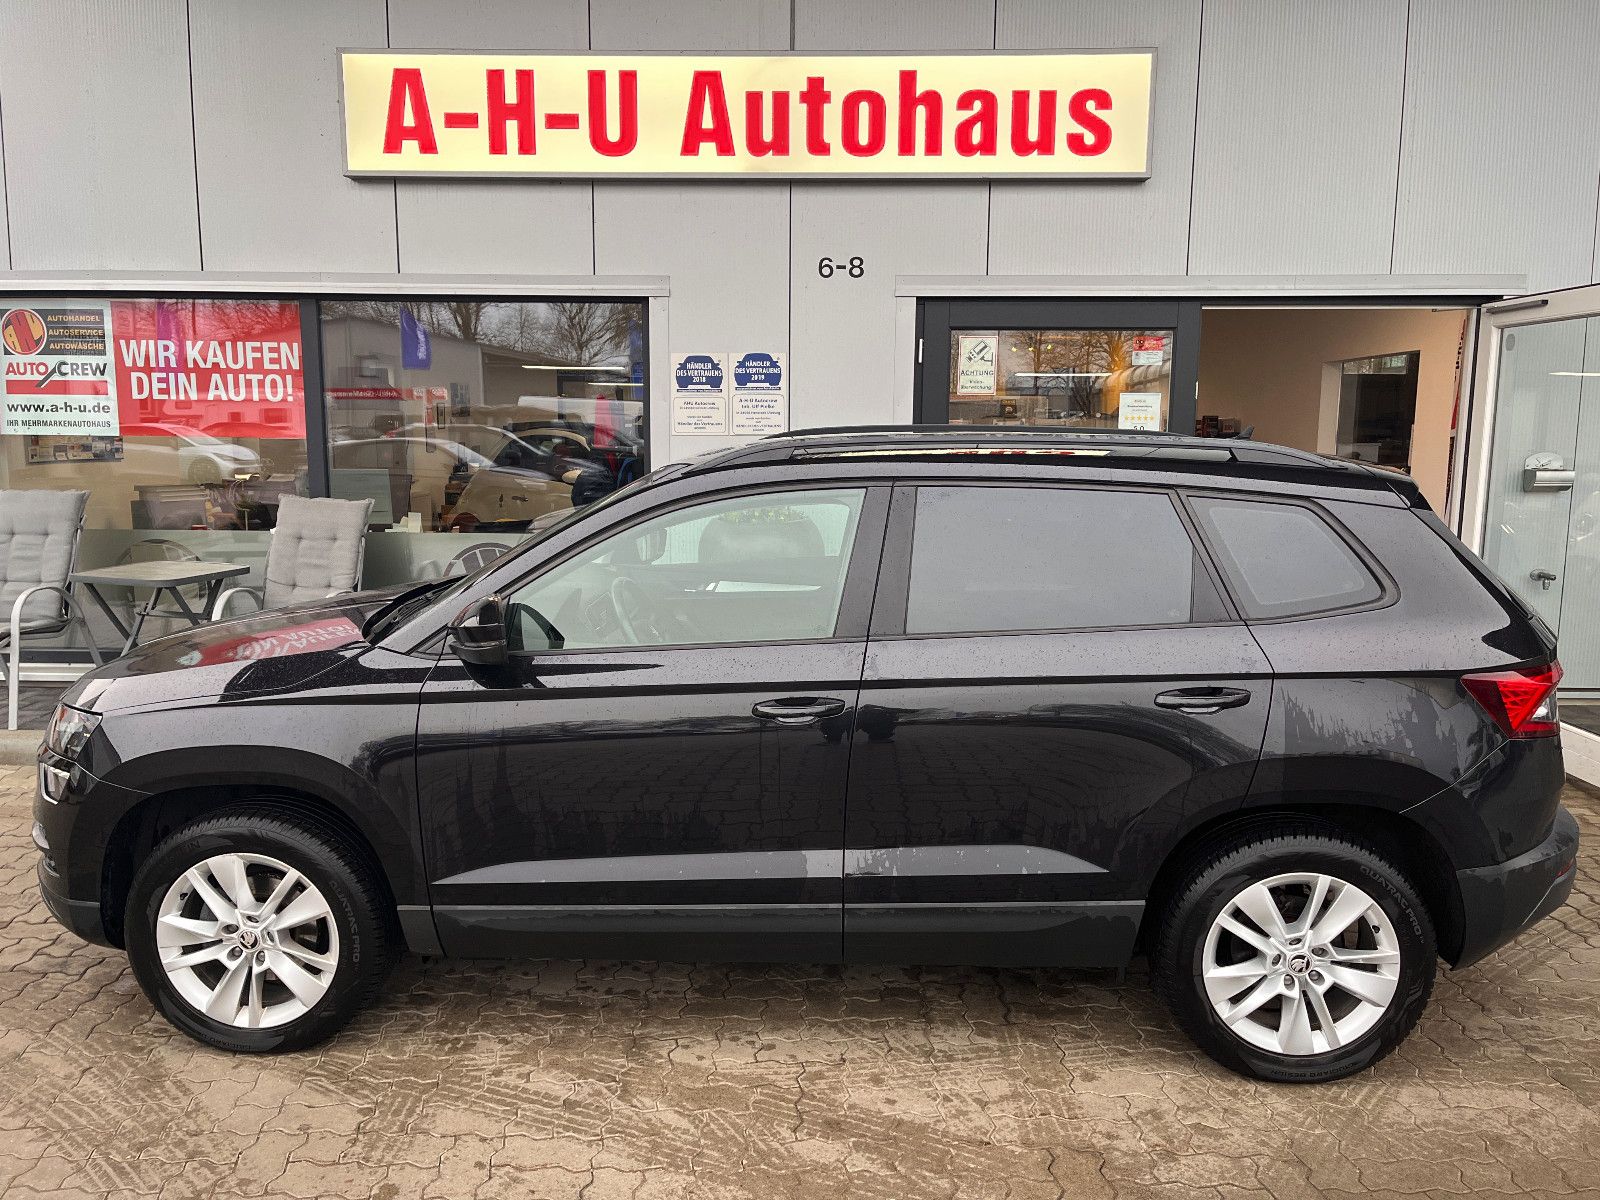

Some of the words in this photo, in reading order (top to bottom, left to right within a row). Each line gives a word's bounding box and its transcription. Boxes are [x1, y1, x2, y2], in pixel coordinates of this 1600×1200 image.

[383, 68, 637, 157] A-H-U
[680, 69, 1113, 157] Autohaus
[818, 256, 865, 279] 6-8
[46, 314, 101, 323] AUTOHANDEL
[47, 328, 104, 337] AUTOSERVICE
[49, 340, 105, 350] AUTOWÄSCHE
[120, 339, 177, 368] WIR
[186, 340, 300, 371] KAUFEN
[5, 361, 49, 377] AUTO
[56, 360, 107, 377] CREW
[686, 362, 712, 370] HÄNDLER
[745, 359, 771, 367] HÄNDLER
[130, 372, 197, 400] DEIN
[207, 374, 294, 402] AUTO!
[6, 401, 111, 414] www.a-h-u.de
[6, 419, 19, 427] IHR
[21, 419, 111, 428] MEHRMARKENAUTOHAUS
